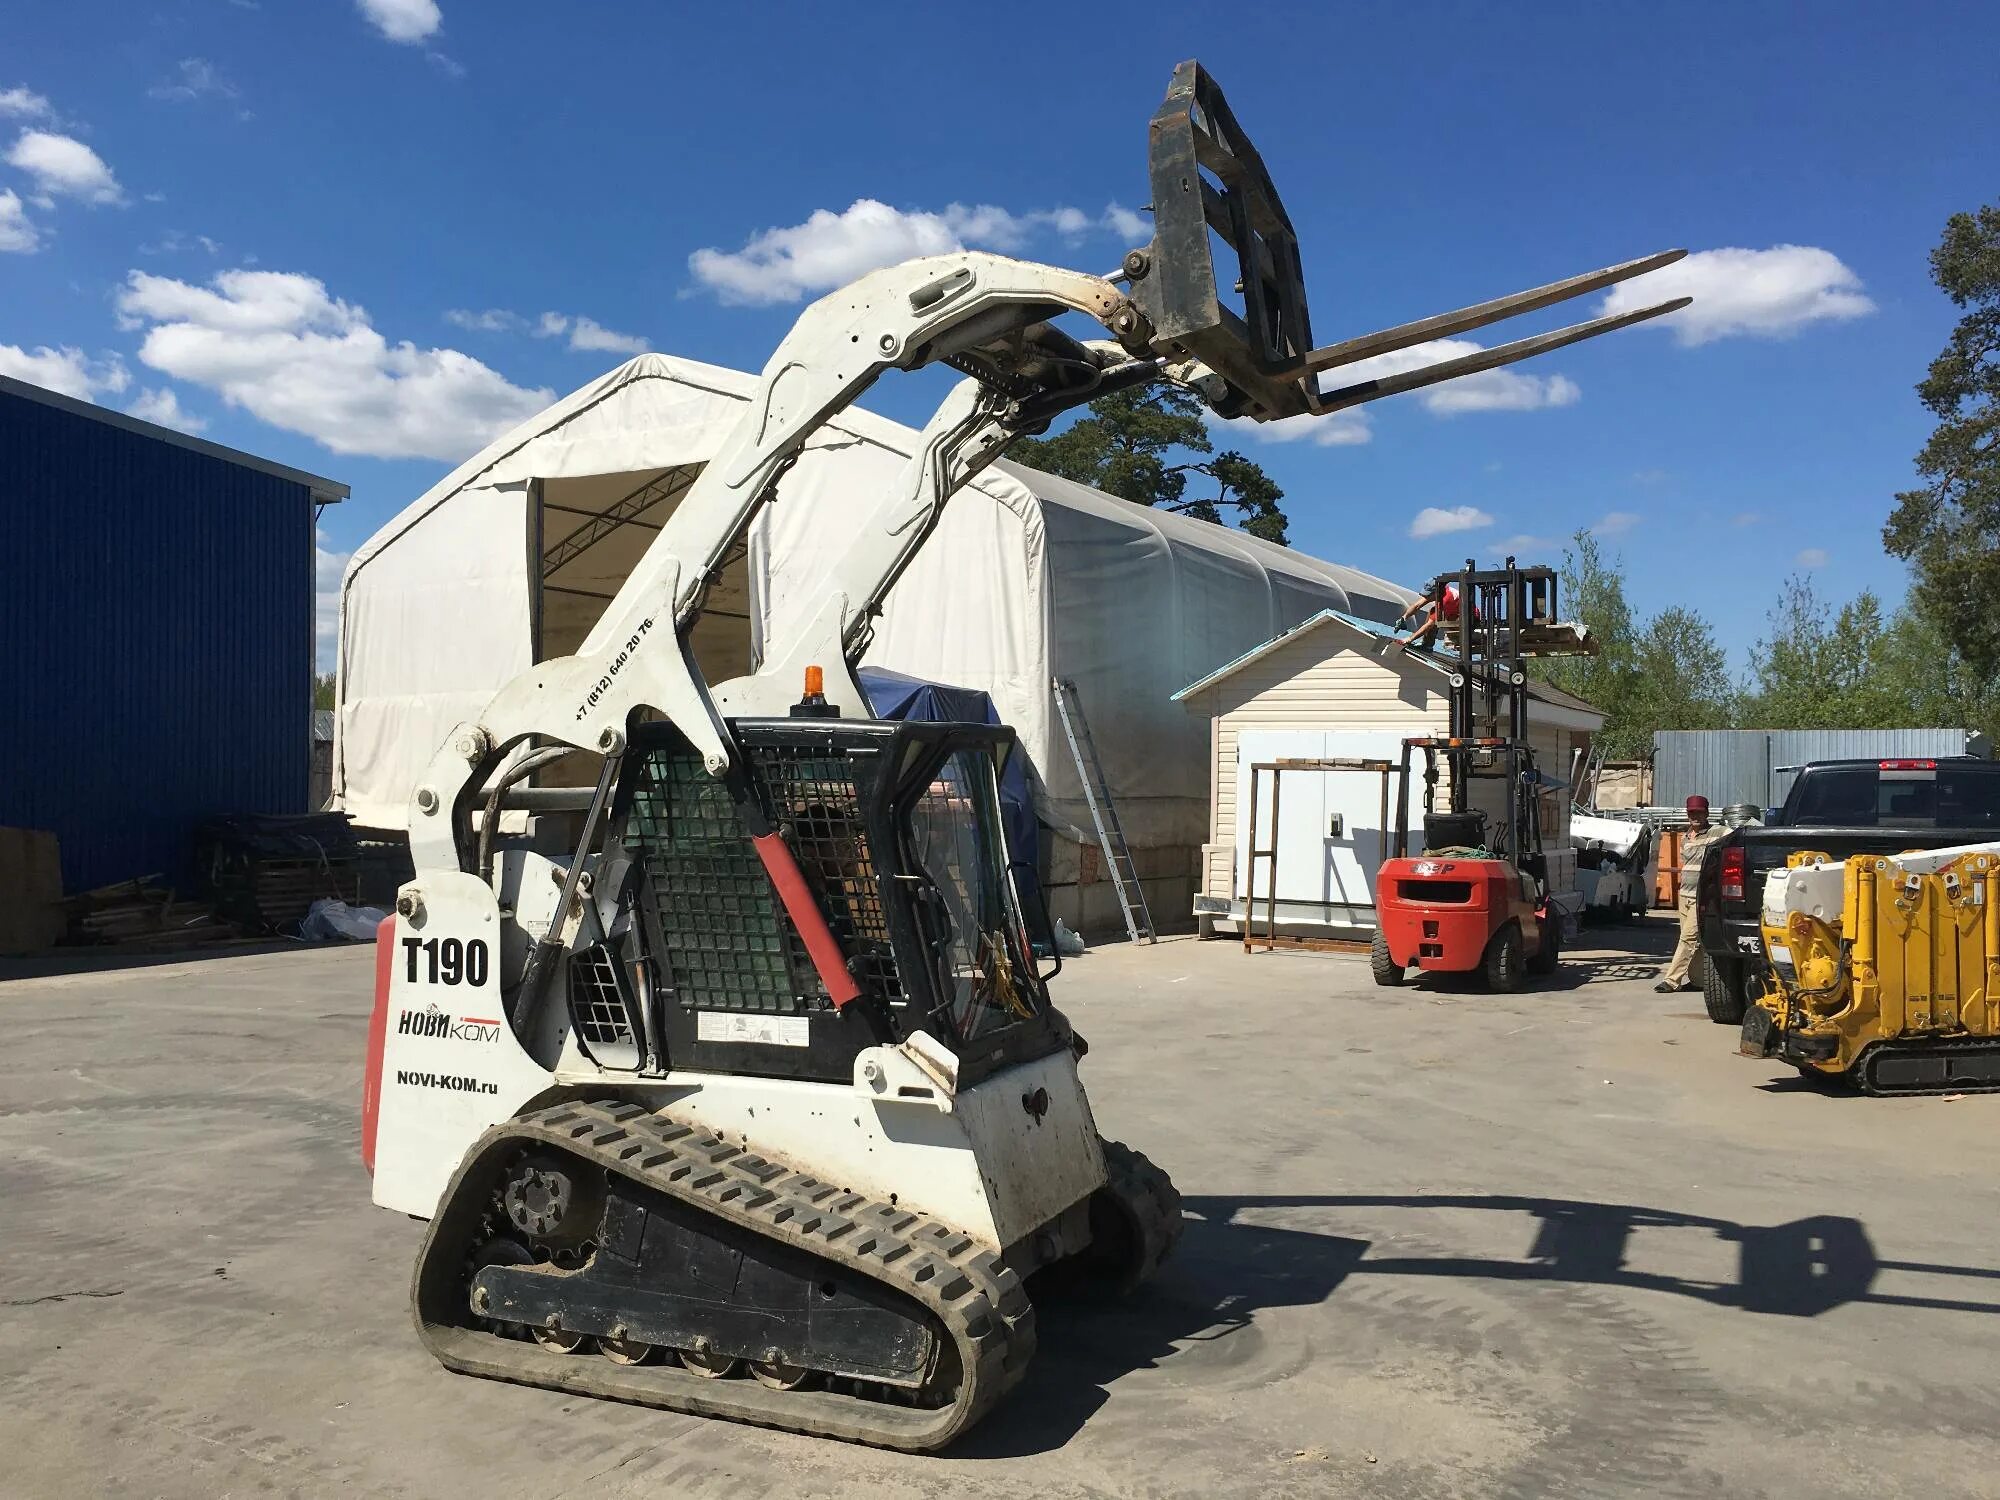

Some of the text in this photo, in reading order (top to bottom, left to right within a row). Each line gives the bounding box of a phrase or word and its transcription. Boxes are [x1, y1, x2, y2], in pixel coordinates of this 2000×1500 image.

[576, 618, 653, 720] +7 (812) 640 20 76
[402, 937, 488, 987] T190
[397, 1070, 498, 1095] NOVI-KOM.ru
